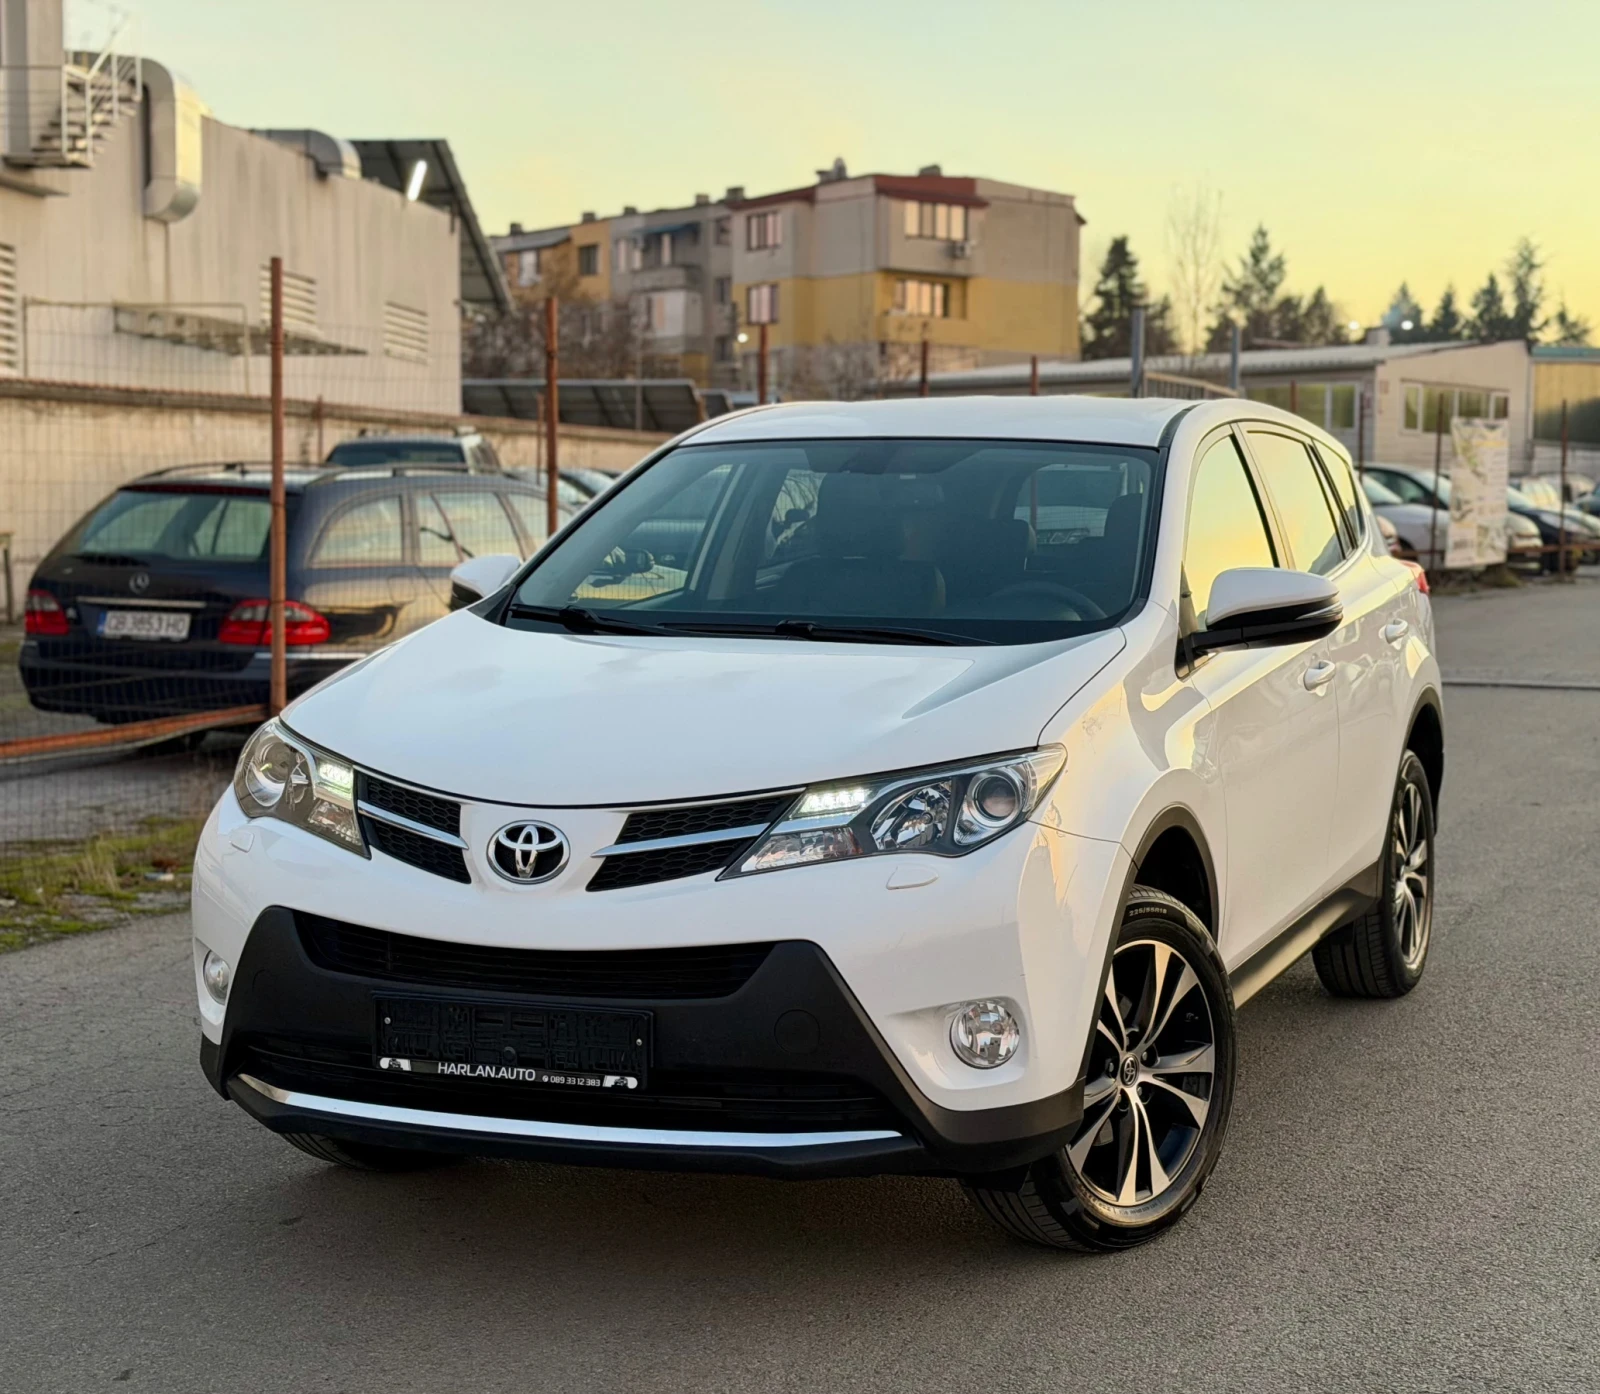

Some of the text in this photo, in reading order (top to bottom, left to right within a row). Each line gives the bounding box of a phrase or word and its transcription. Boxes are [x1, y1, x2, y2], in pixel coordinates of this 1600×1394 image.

[437, 1062, 536, 1081] HARLAN.AUTO
[550, 1075, 565, 1084] 089
[566, 1077, 576, 1085] 33
[586, 1078, 601, 1087] 383
